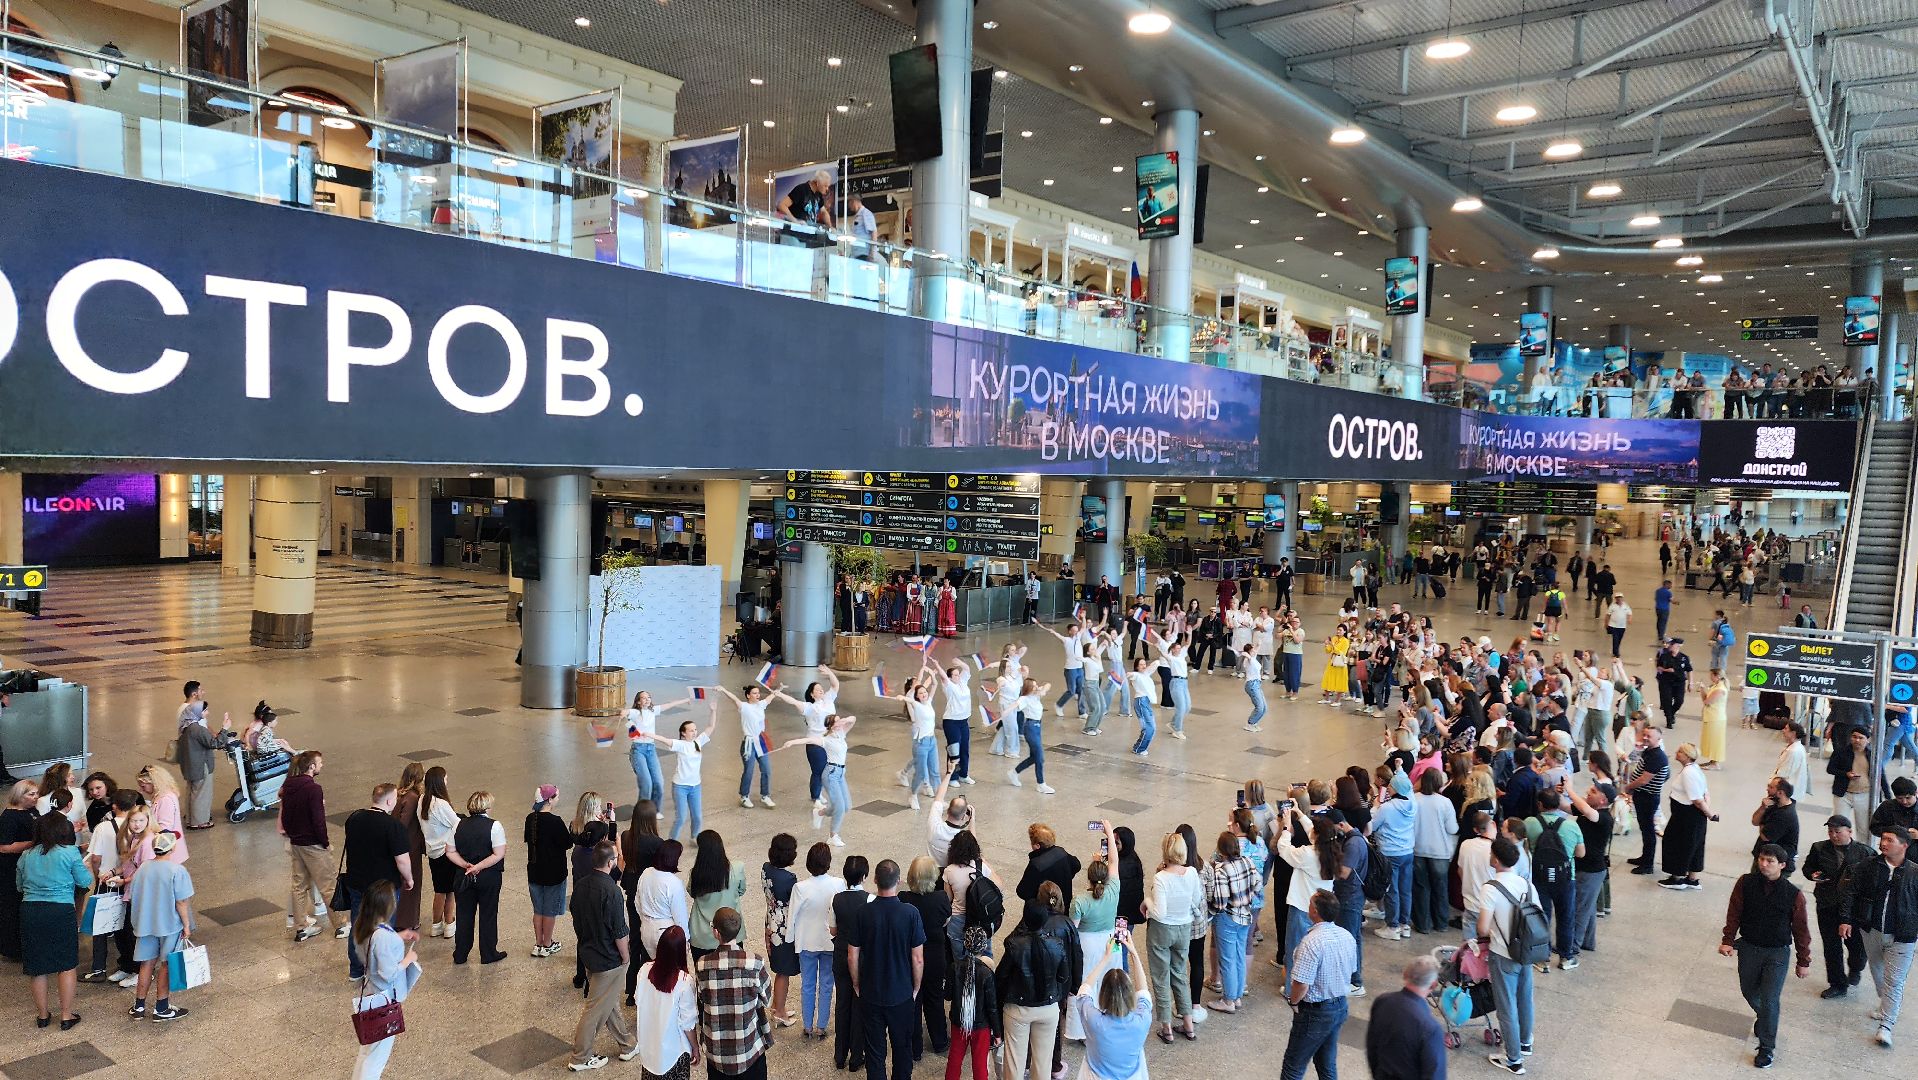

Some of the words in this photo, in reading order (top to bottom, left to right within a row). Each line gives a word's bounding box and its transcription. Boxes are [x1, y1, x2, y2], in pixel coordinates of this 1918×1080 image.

[0, 258, 643, 417] СТРОВ.
[969, 358, 1137, 415] КУРОРТНАЯ
[1142, 384, 1220, 421] ЖИЗНЬ
[1041, 421, 1060, 460] В
[1068, 421, 1170, 464] МОСКВЕ
[1328, 413, 1423, 461] ОСТРОВ.
[1469, 423, 1536, 450] КУРОРТНАЯ
[1540, 431, 1632, 452] ЖИЗНЬ
[1486, 454, 1494, 475] В
[1494, 454, 1568, 477] МОСКВЕ
[1742, 462, 1807, 476] ДОНСТРОЙ
[1801, 645, 1833, 655] ВЫЛЕТ
[1799, 675, 1836, 685] ТУАЛЕТ
